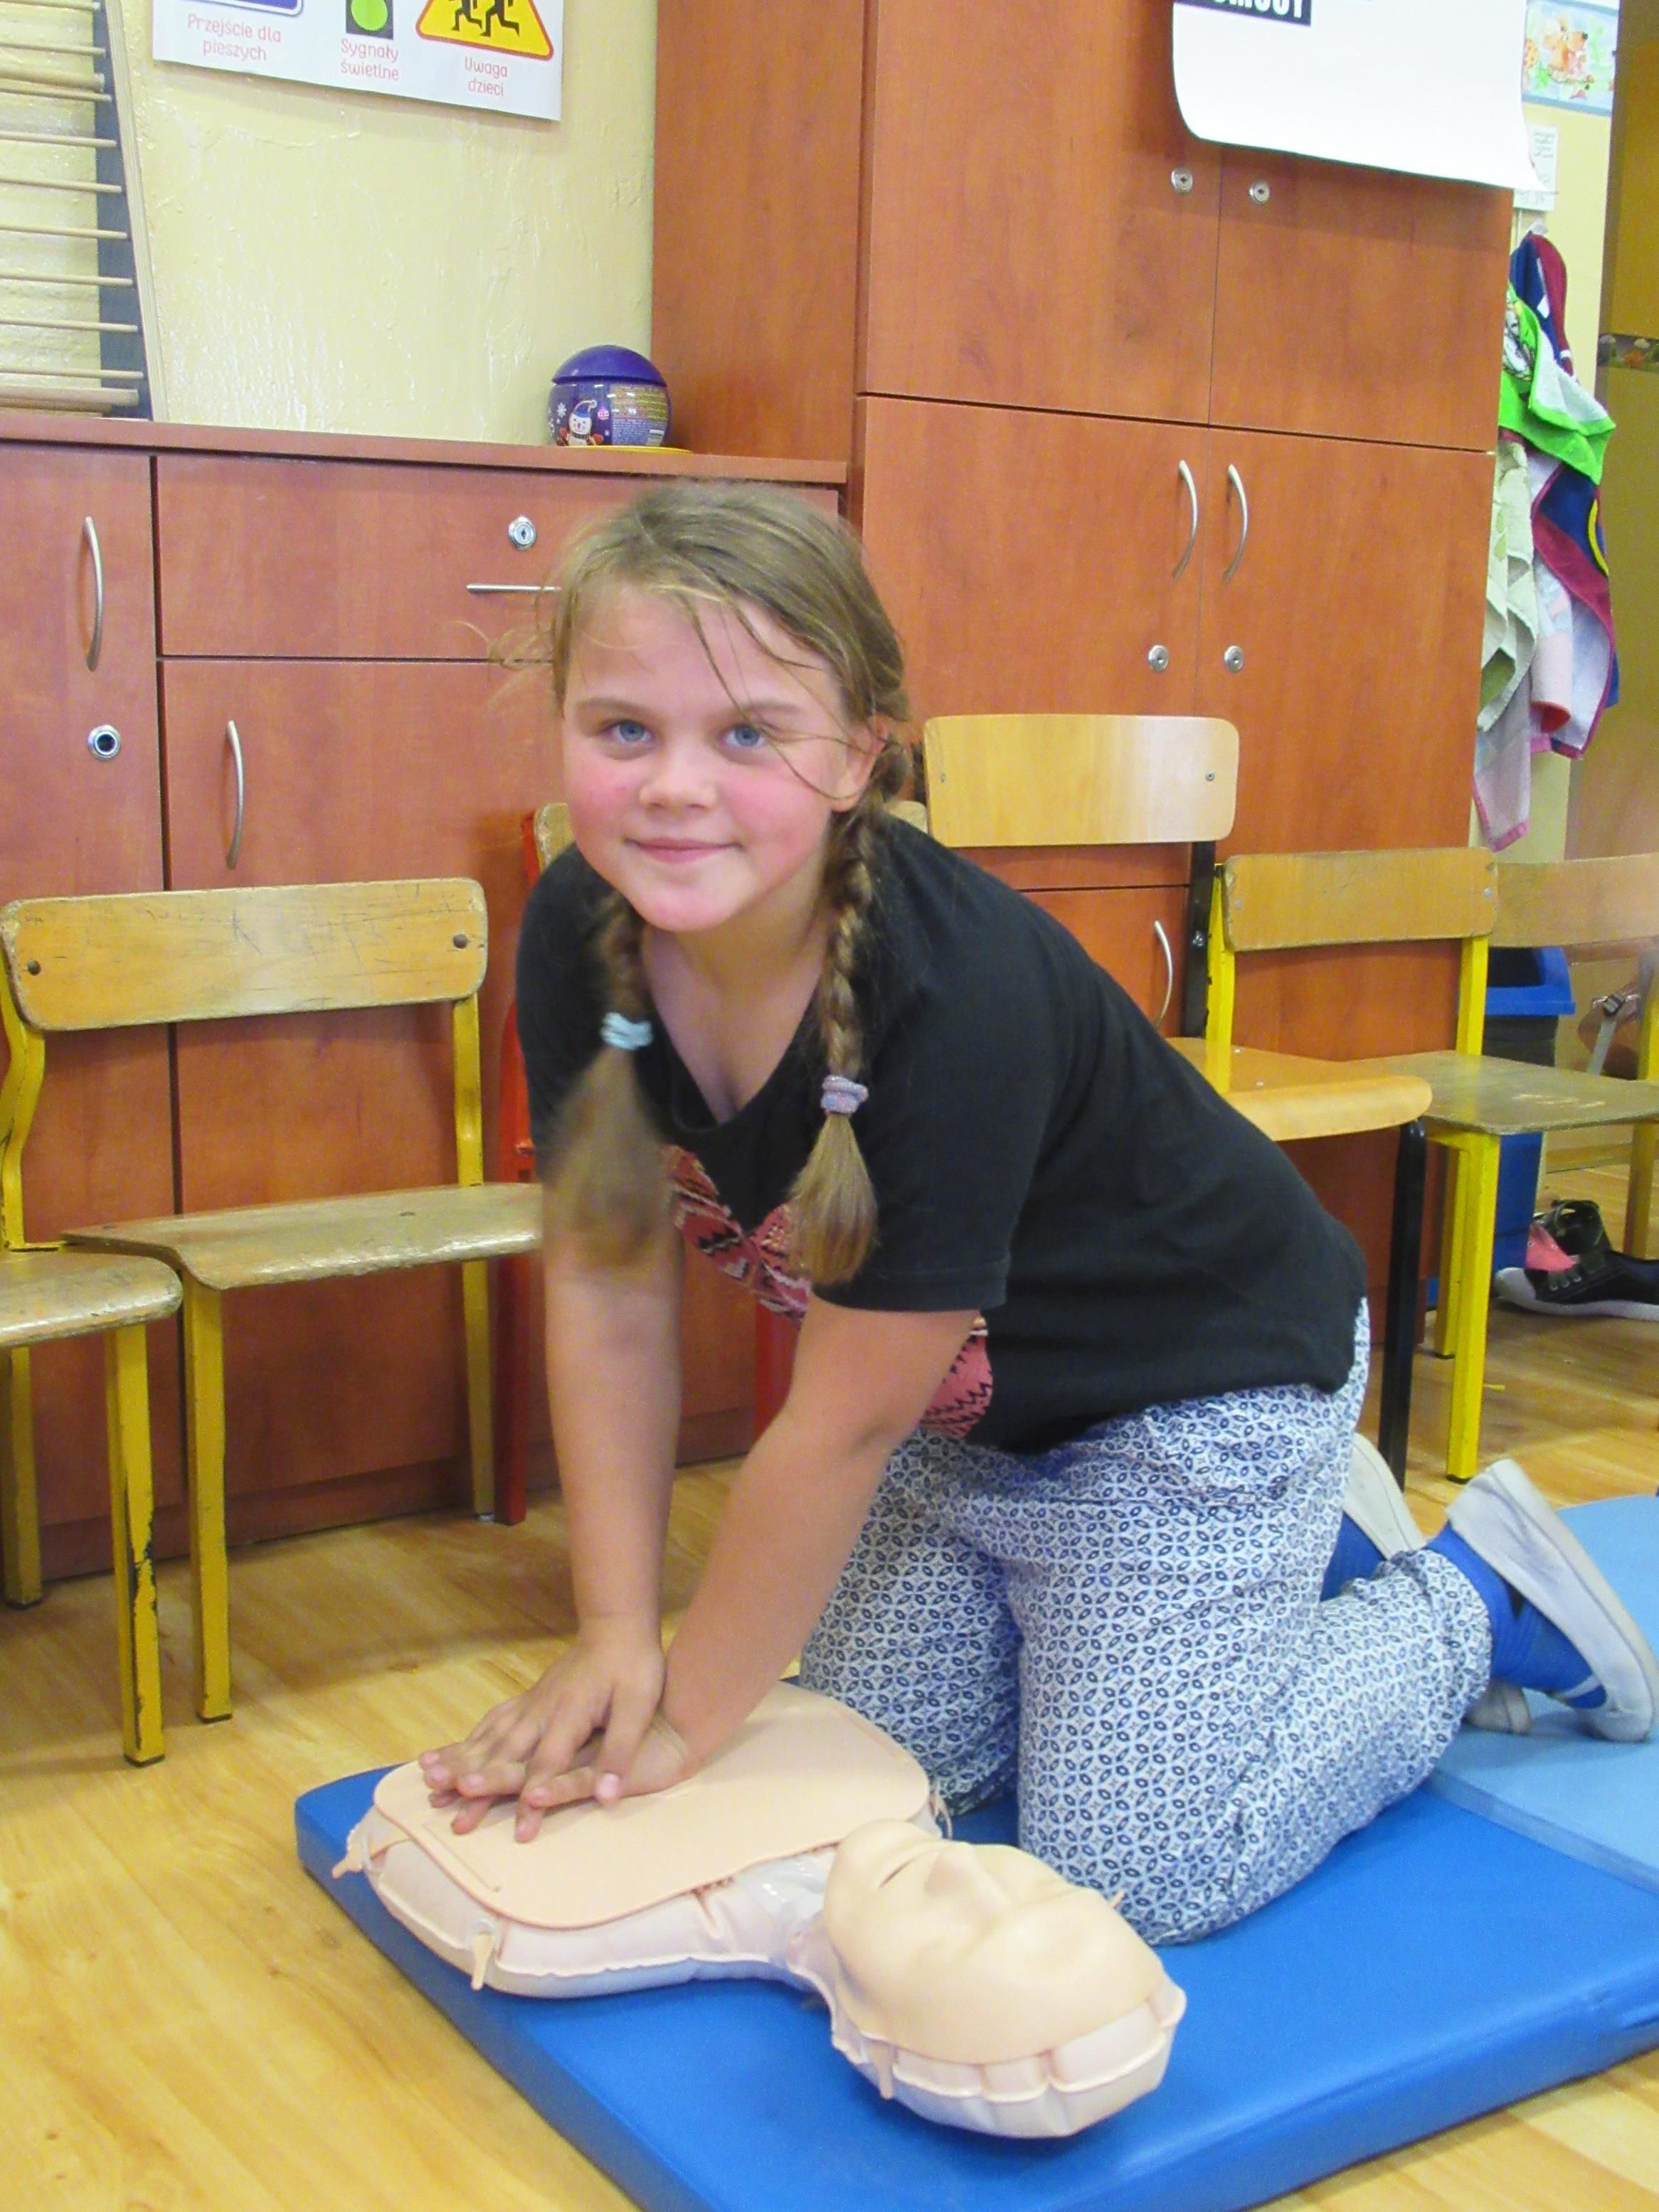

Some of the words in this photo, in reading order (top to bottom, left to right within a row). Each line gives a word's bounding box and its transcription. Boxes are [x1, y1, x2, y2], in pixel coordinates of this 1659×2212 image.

[187, 13, 253, 38] Przejście
[258, 25, 282, 43] dla
[203, 40, 267, 61] pieszych
[341, 38, 398, 63] Sygnały
[341, 60, 399, 81] świetlne
[465, 56, 508, 79] Uwaga
[468, 78, 504, 97] dzieci
